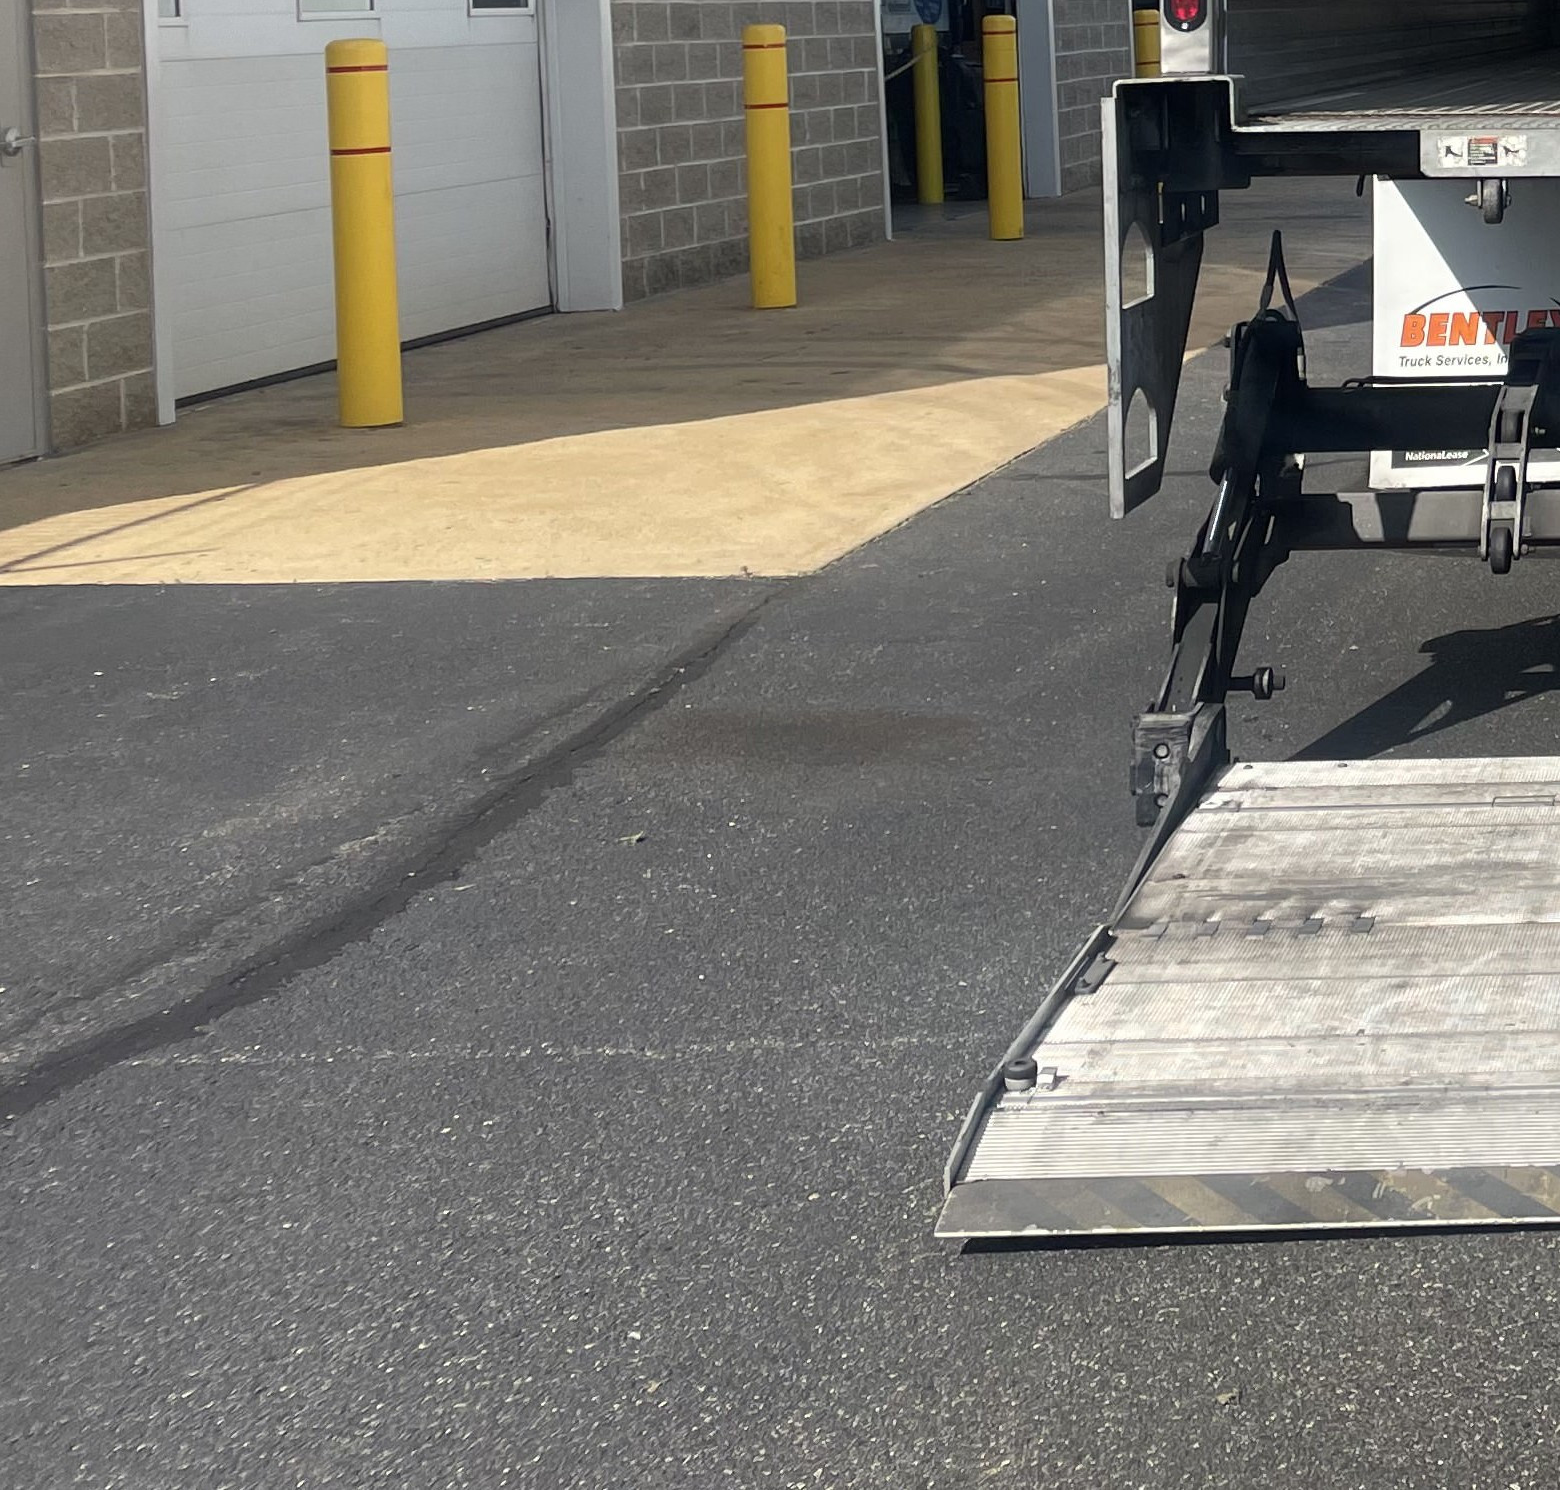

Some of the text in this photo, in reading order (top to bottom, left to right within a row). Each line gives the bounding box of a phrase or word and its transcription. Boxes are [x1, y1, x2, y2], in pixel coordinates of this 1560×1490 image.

[1399, 354, 1432, 367] Truck
[1435, 353, 1492, 367] Services,
[1405, 450, 1469, 461] NationaLease
